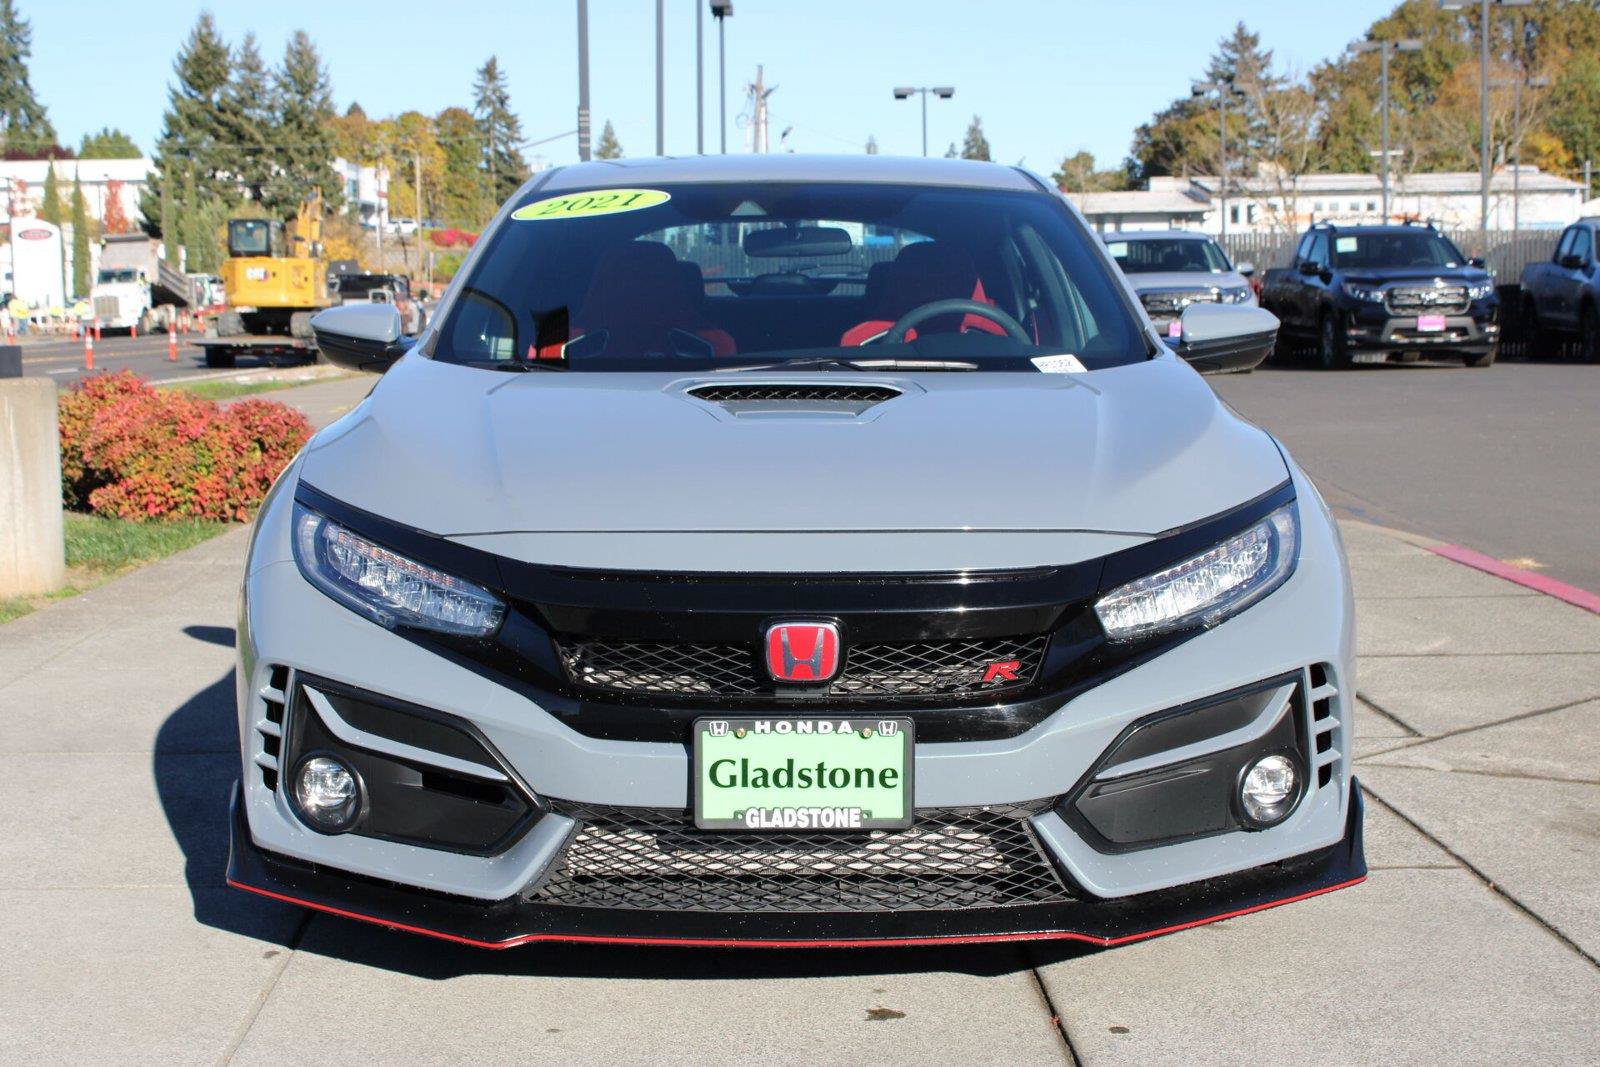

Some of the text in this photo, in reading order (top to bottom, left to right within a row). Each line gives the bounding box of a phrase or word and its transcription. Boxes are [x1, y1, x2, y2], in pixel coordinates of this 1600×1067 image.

[538, 192, 645, 216] 2021
[980, 659, 1023, 683] R
[754, 720, 854, 734] HONDA
[708, 758, 899, 789] Gladstone
[745, 807, 862, 828] GLADSTONE
